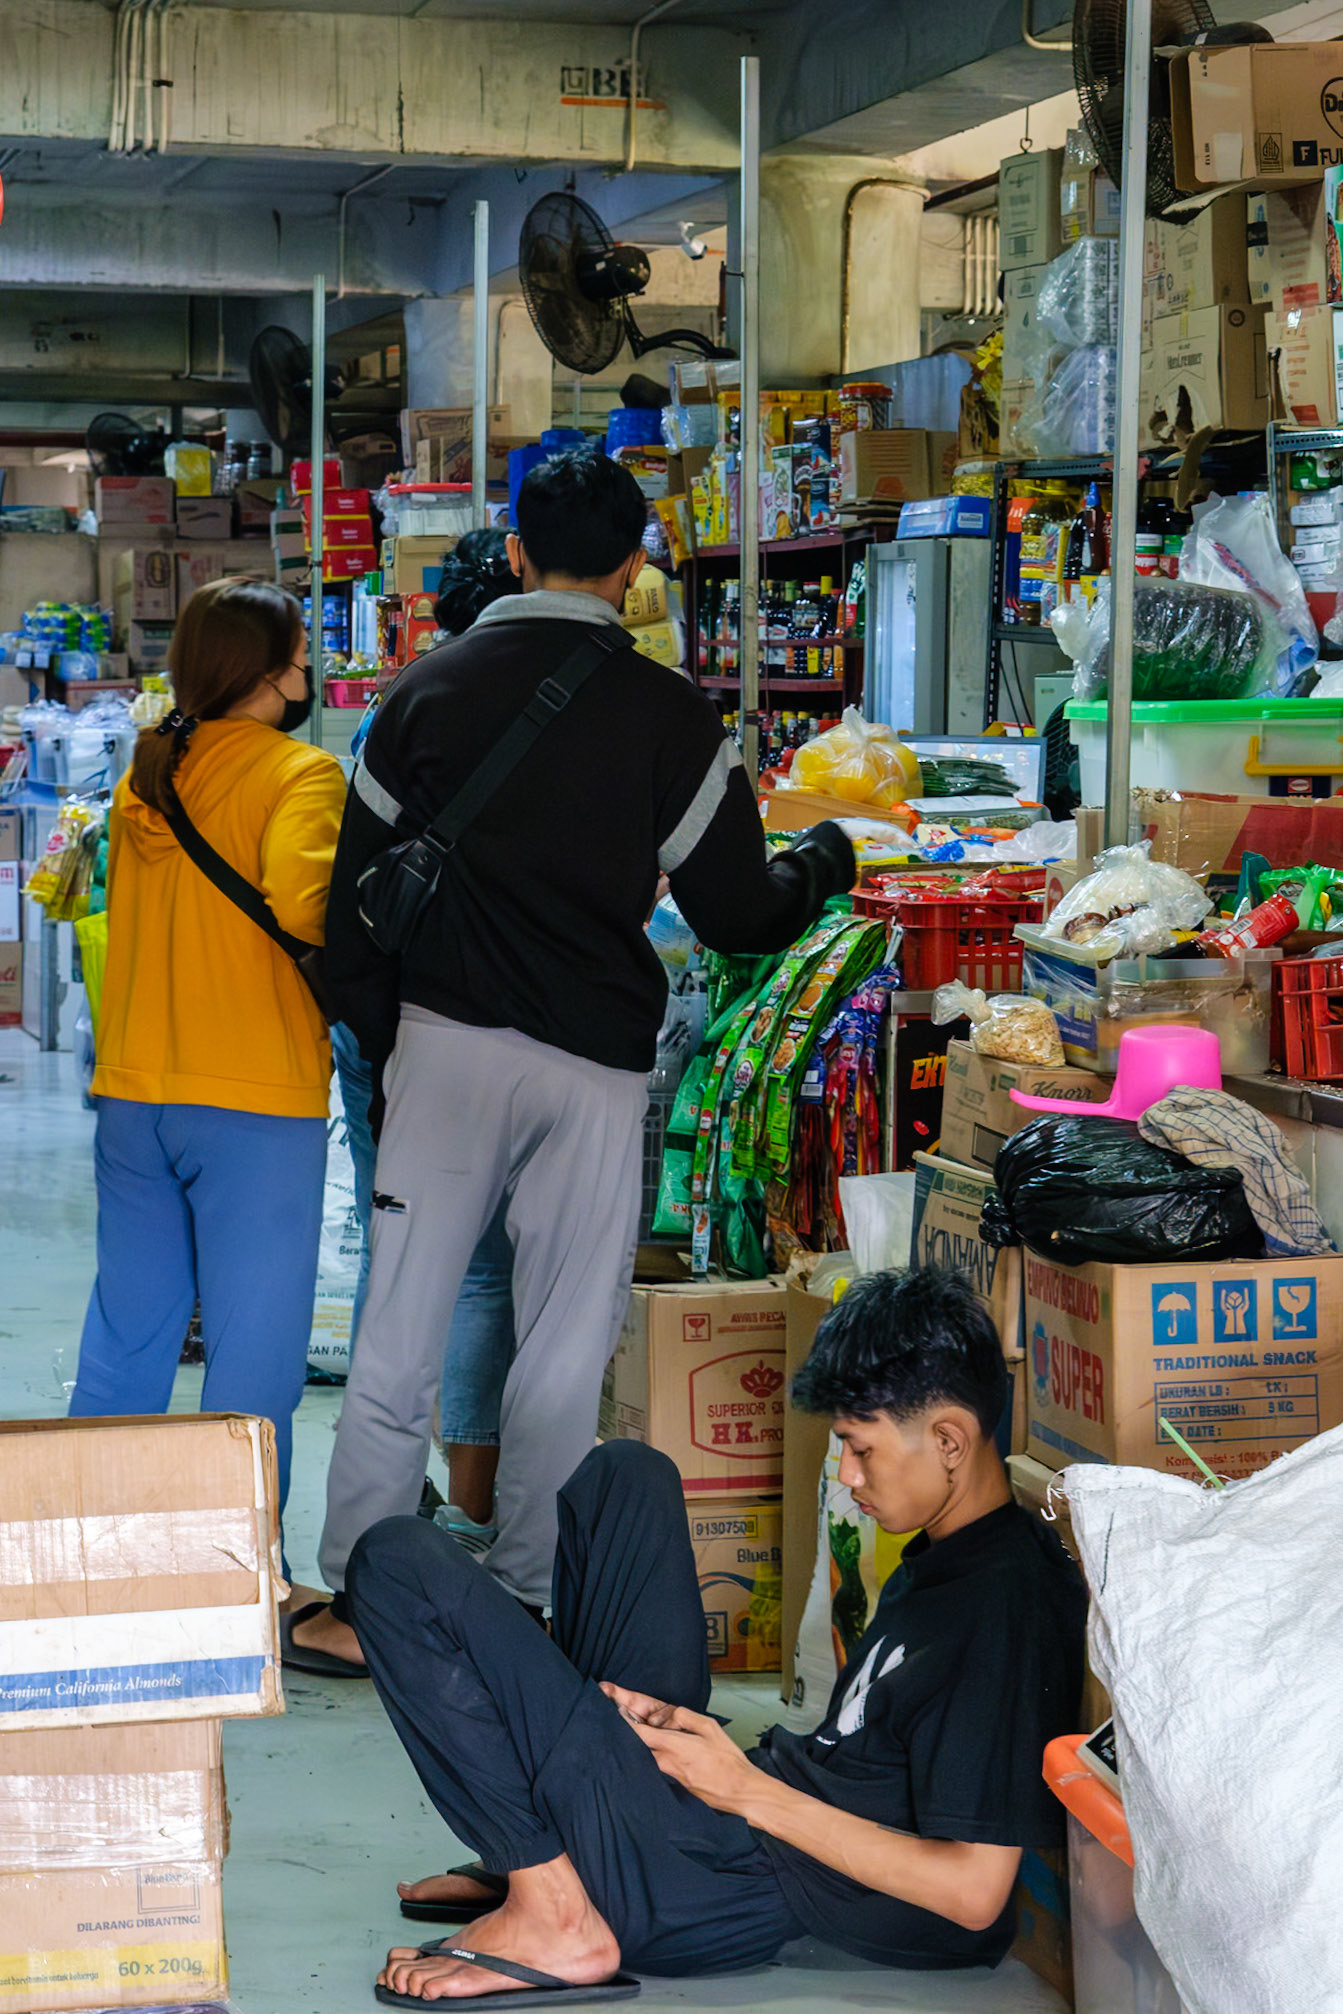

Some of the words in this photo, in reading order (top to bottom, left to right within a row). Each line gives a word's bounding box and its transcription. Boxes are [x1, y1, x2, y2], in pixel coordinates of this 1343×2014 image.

[1032, 1080, 1094, 1101] Knorr
[1152, 1354, 1258, 1371] TRADITIONAL
[1263, 1350, 1318, 1366] SNACK
[1051, 1335, 1105, 1425] SUPER
[706, 1401, 767, 1418] SUPERIOR
[1160, 1406, 1196, 1419] BERAT
[737, 1548, 769, 1563] Blue
[55, 1680, 121, 1697] California
[124, 1674, 182, 1691] Almonds
[77, 1920, 134, 1932] DILARANG
[136, 1914, 200, 1928] DIBANTING!
[119, 1961, 141, 1976] 60
[144, 1964, 155, 1974] x
